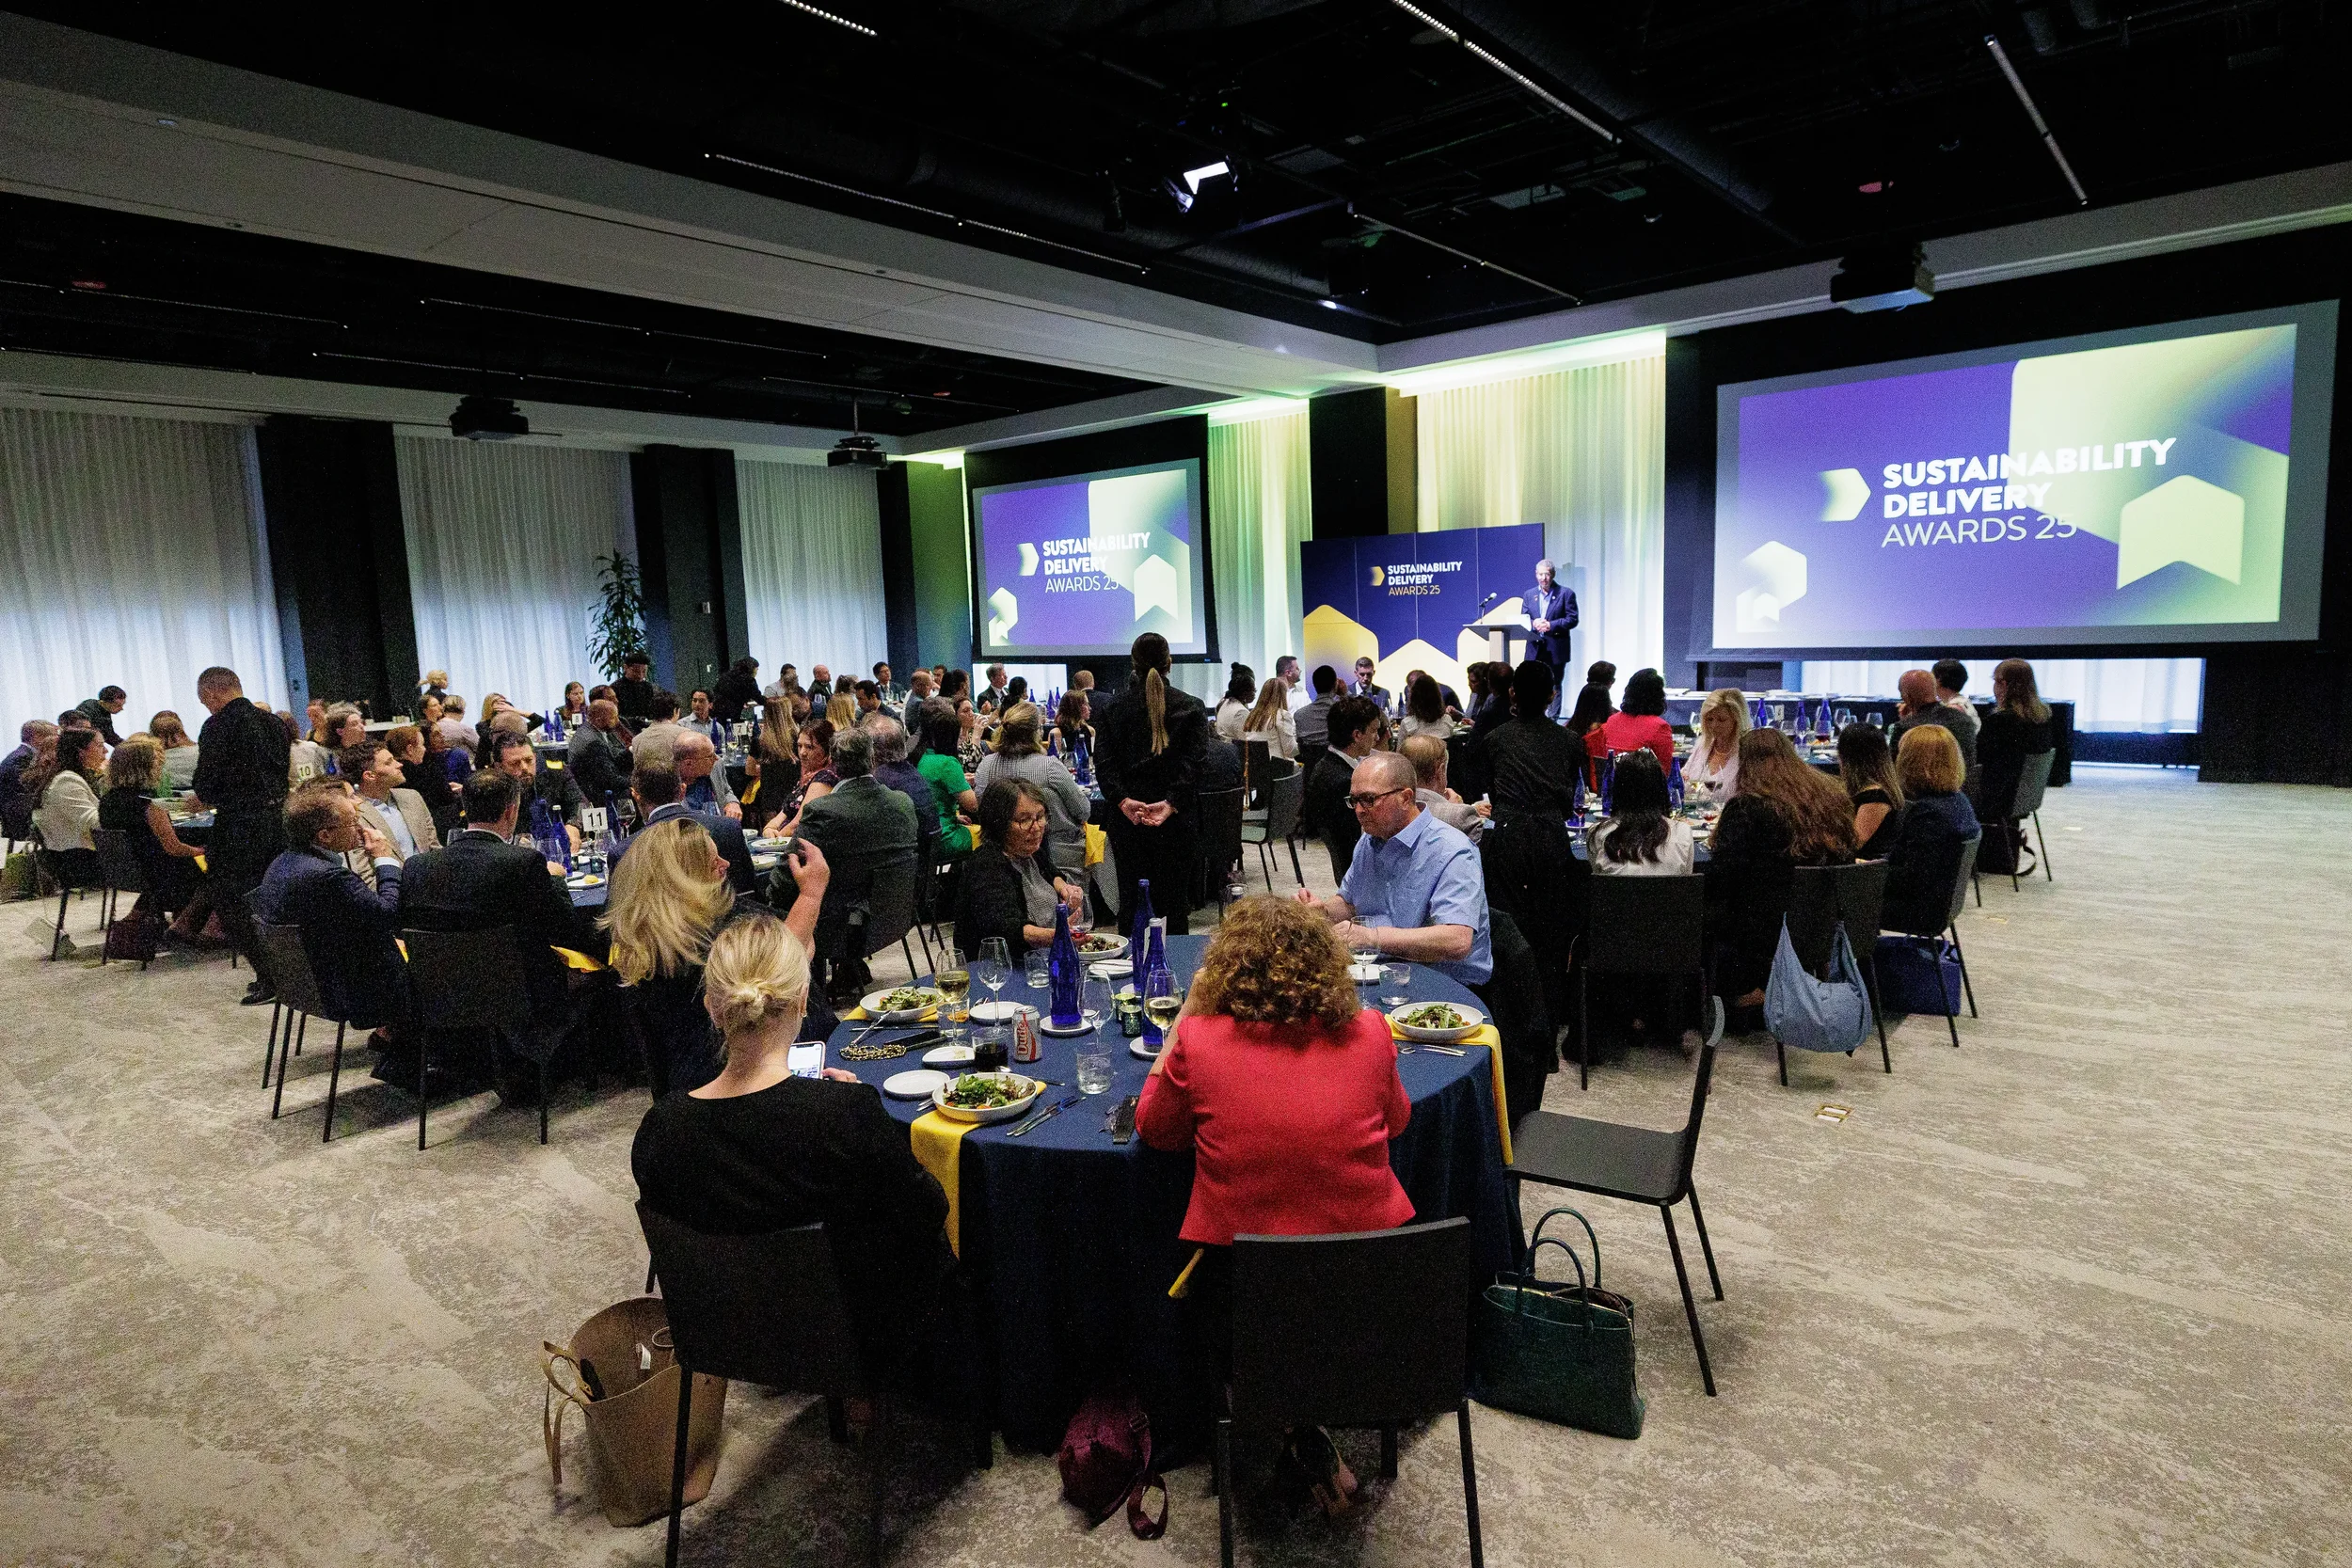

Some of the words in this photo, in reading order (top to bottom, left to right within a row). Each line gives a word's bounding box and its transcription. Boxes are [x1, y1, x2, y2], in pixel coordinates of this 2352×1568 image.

[1883, 436, 2177, 489] SUSTAINABILITY
[1883, 482, 2053, 519] DELIVERY
[1881, 515, 2027, 548] AWARDS
[2034, 513, 2078, 540] 25
[1042, 531, 1151, 557] SUSTAINABILITY
[1043, 556, 1109, 576] DELIVERY
[1387, 561, 1463, 575] SUSTAINABILITY
[1044, 576, 1101, 594] AWARDS
[1103, 575, 1120, 591] 25
[1388, 574, 1434, 586] DELIVERY
[1388, 585, 1428, 596] AWARDS
[1429, 584, 1441, 595] 25
[299, 766, 311, 777] 10
[587, 812, 603, 828] 11
